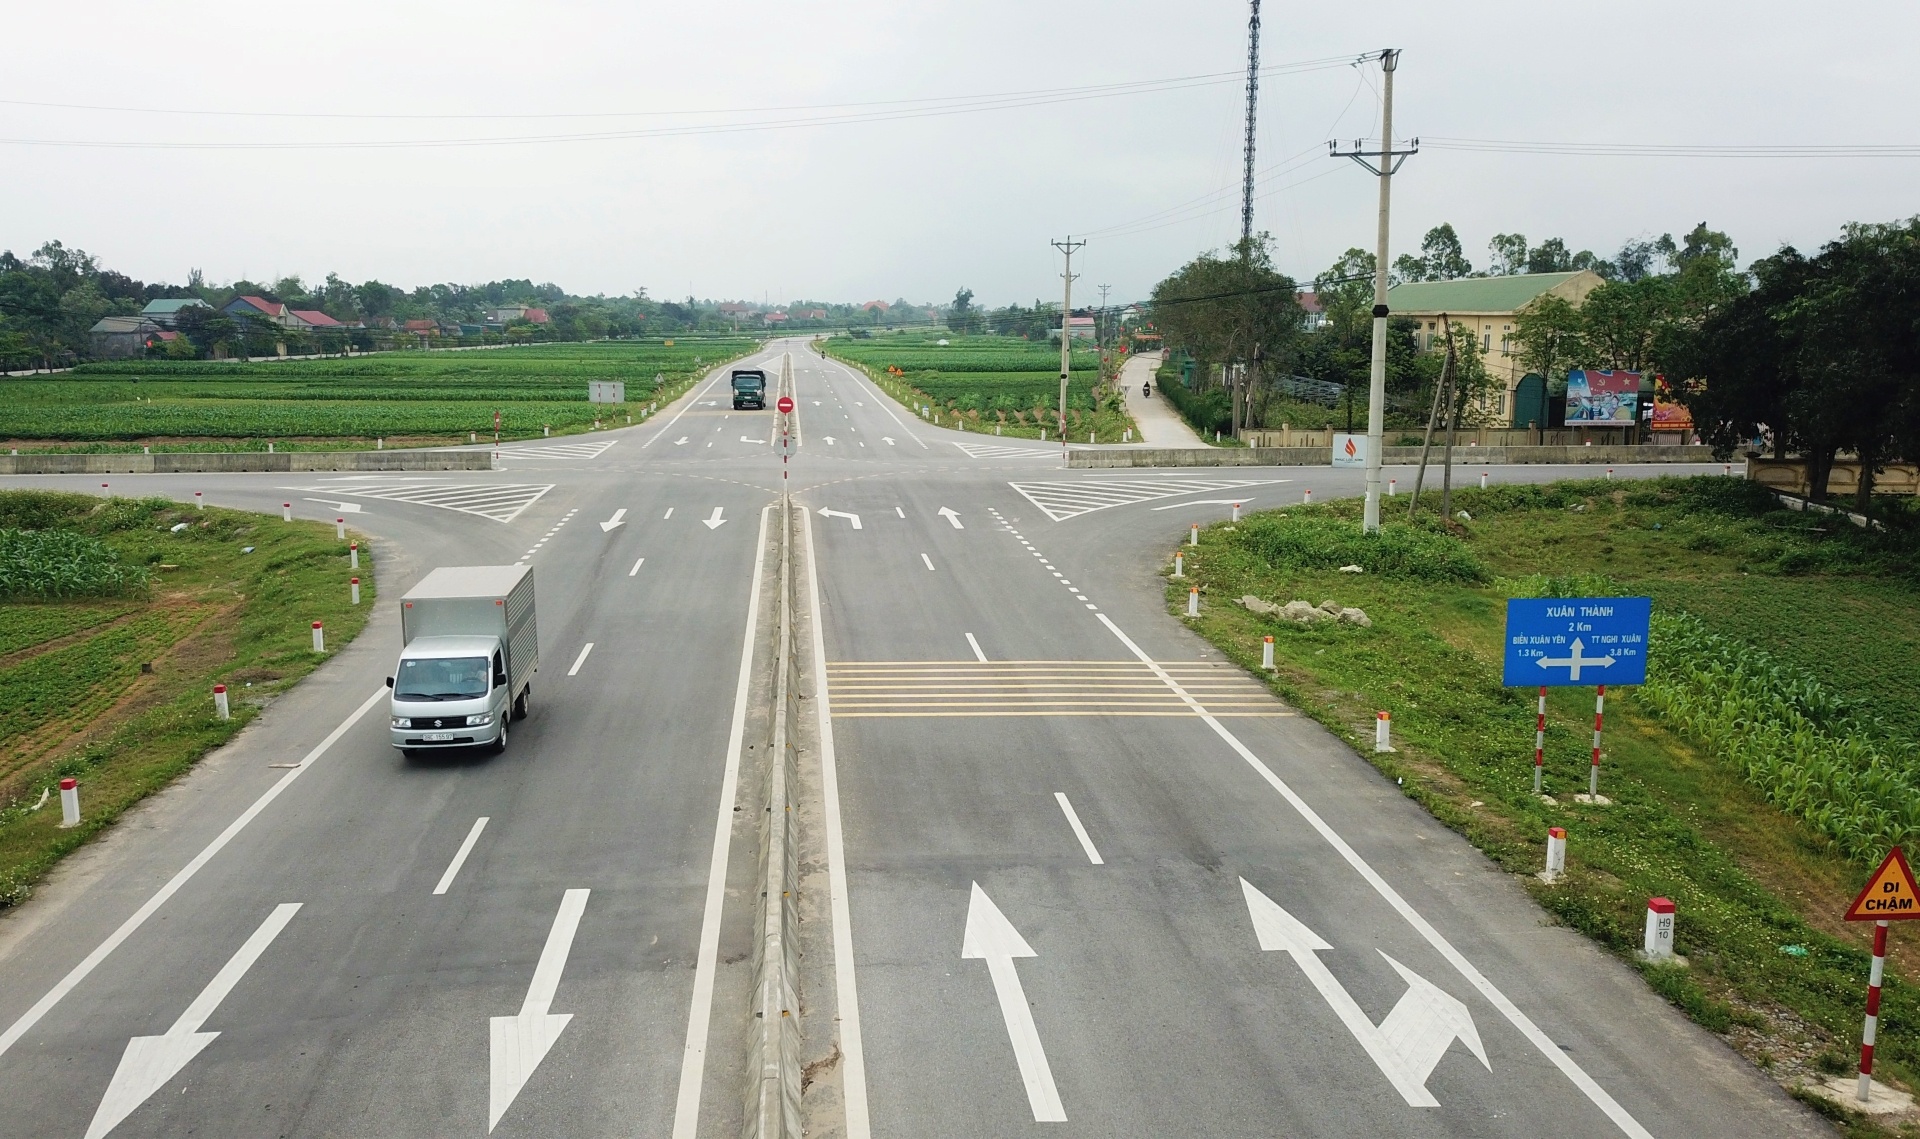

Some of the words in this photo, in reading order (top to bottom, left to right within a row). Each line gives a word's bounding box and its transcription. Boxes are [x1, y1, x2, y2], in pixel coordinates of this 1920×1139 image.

[1546, 605, 1575, 617] XUÂN
[1580, 604, 1614, 617] THÀNH
[1568, 622, 1575, 632] 2
[1577, 622, 1592, 632] Km
[1513, 633, 1528, 645] BIỂN
[1530, 635, 1550, 644] XUÂN
[1552, 634, 1566, 644] YÊN
[1591, 635, 1600, 643] TT
[1601, 635, 1618, 643] NGHI
[1621, 633, 1641, 643] XUÂN
[1518, 649, 1529, 657] 1.3
[1530, 649, 1544, 657] Km
[1610, 648, 1622, 656] 3.8
[1623, 648, 1636, 656] Km
[1883, 882, 1899, 893] ĐI
[1865, 896, 1913, 911] CHẬM
[1659, 918, 1671, 927] H9
[1659, 931, 1669, 939] 10
